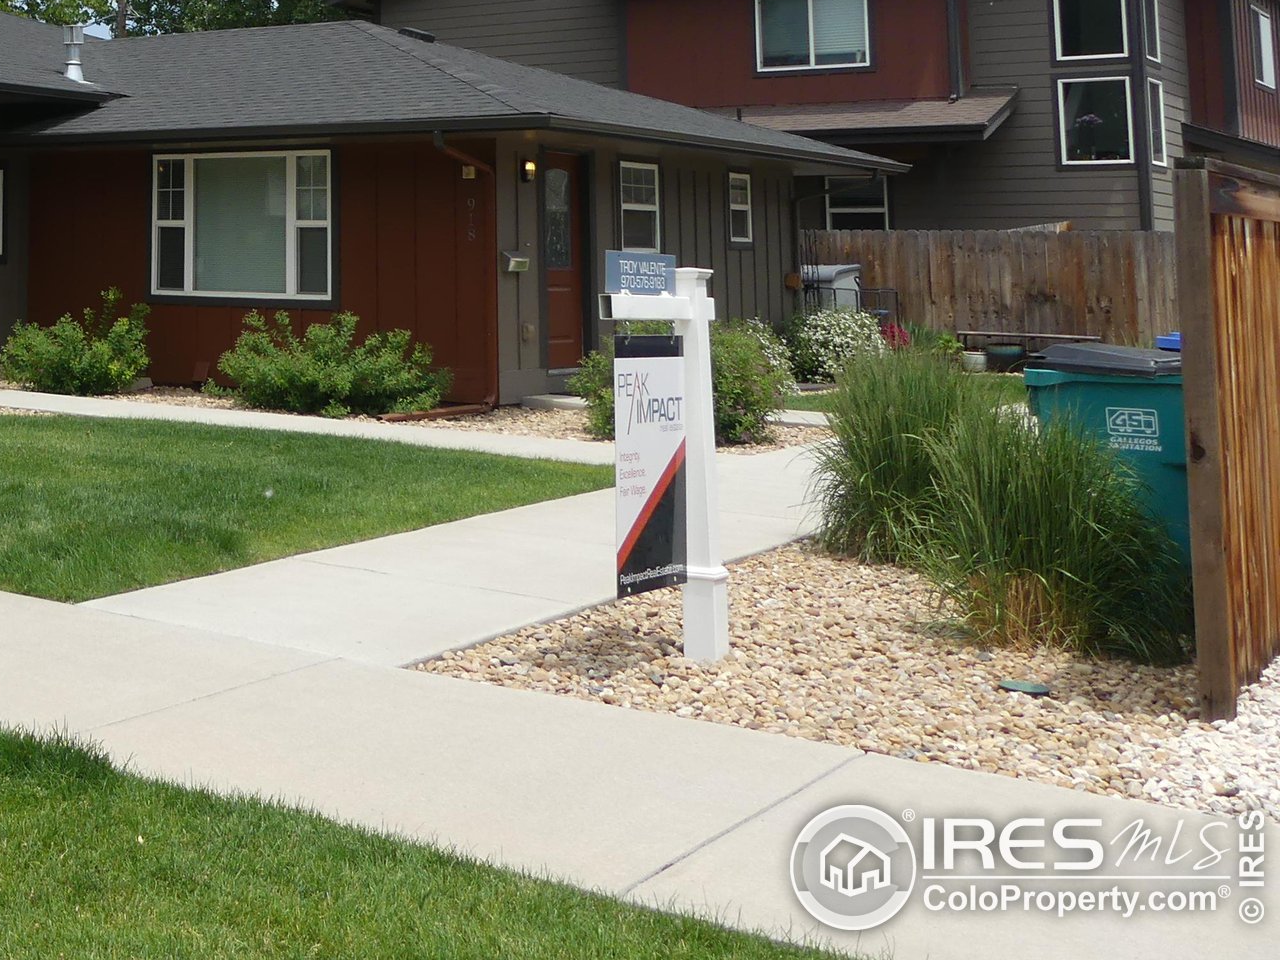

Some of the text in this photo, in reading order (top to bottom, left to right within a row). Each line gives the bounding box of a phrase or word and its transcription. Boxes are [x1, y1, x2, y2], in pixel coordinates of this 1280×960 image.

[619, 260, 666, 275] TROY VALENTE
[636, 397, 682, 424] IMPACT
[1110, 436, 1158, 445] GALLEGOS
